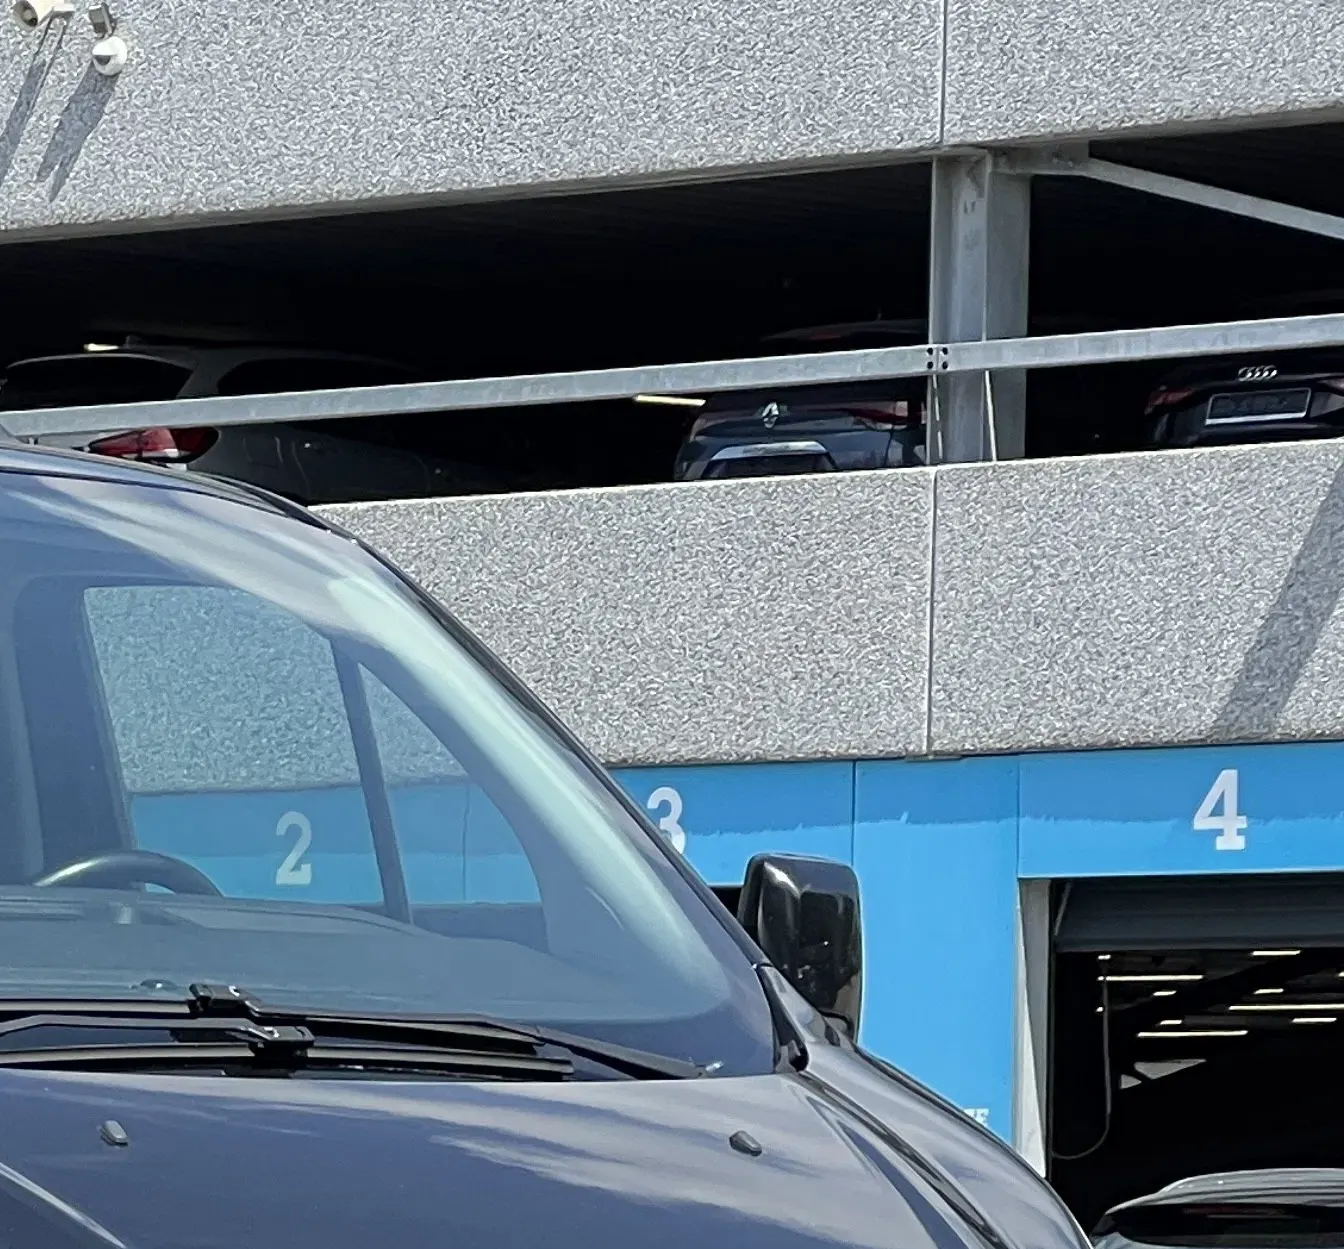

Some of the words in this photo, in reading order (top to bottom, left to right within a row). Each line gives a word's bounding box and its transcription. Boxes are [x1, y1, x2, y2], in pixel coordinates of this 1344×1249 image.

[647, 787, 685, 854] 3
[1193, 769, 1247, 850] 4
[276, 811, 312, 886] 2
